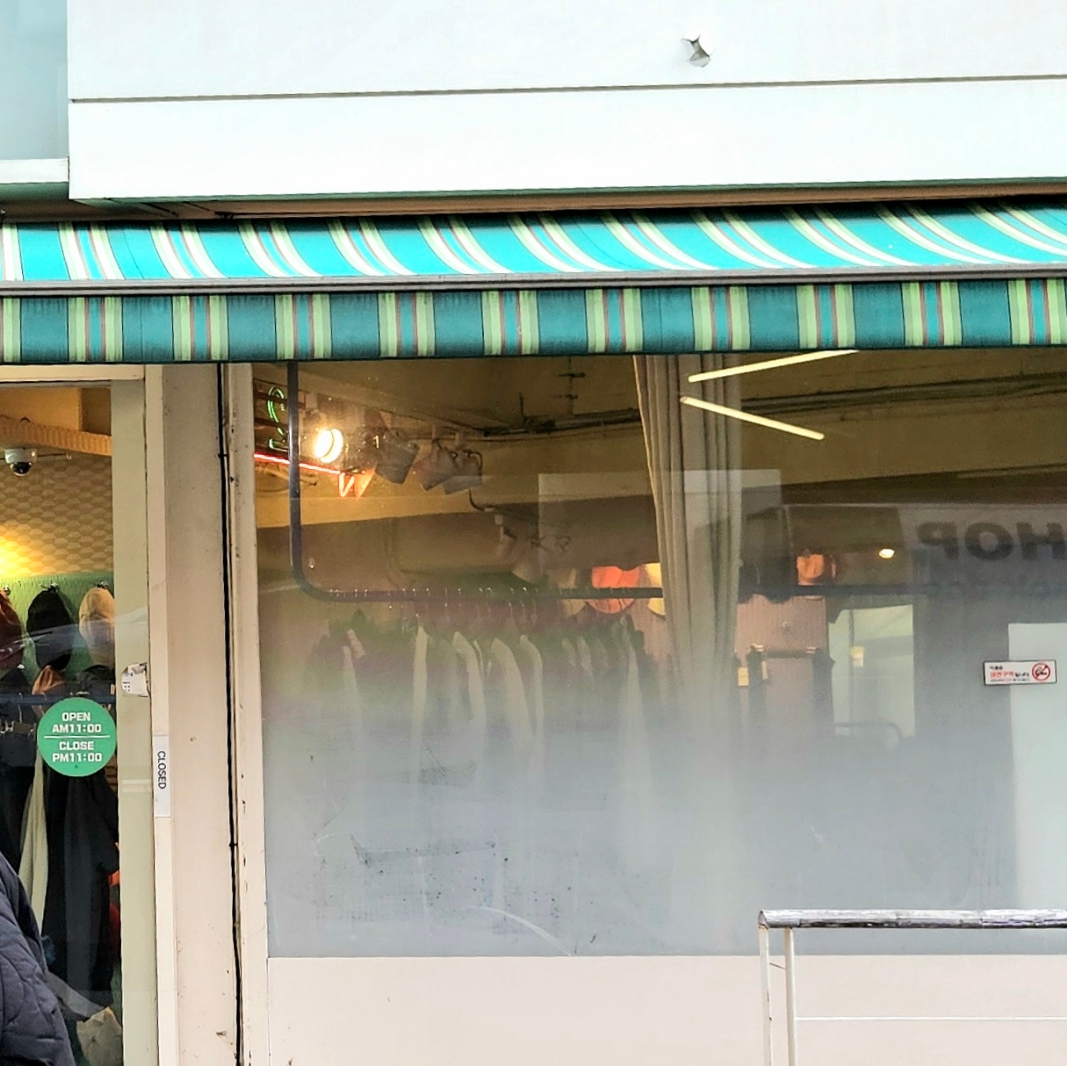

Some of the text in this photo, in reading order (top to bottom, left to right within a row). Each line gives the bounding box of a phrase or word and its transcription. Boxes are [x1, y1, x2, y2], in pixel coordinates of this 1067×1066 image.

[61, 712, 91, 721] OPEN
[52, 724, 102, 733] AM11:00
[59, 741, 94, 751] CLOSE
[52, 753, 102, 762] PM11:00
[157, 750, 167, 789] CLOSED
